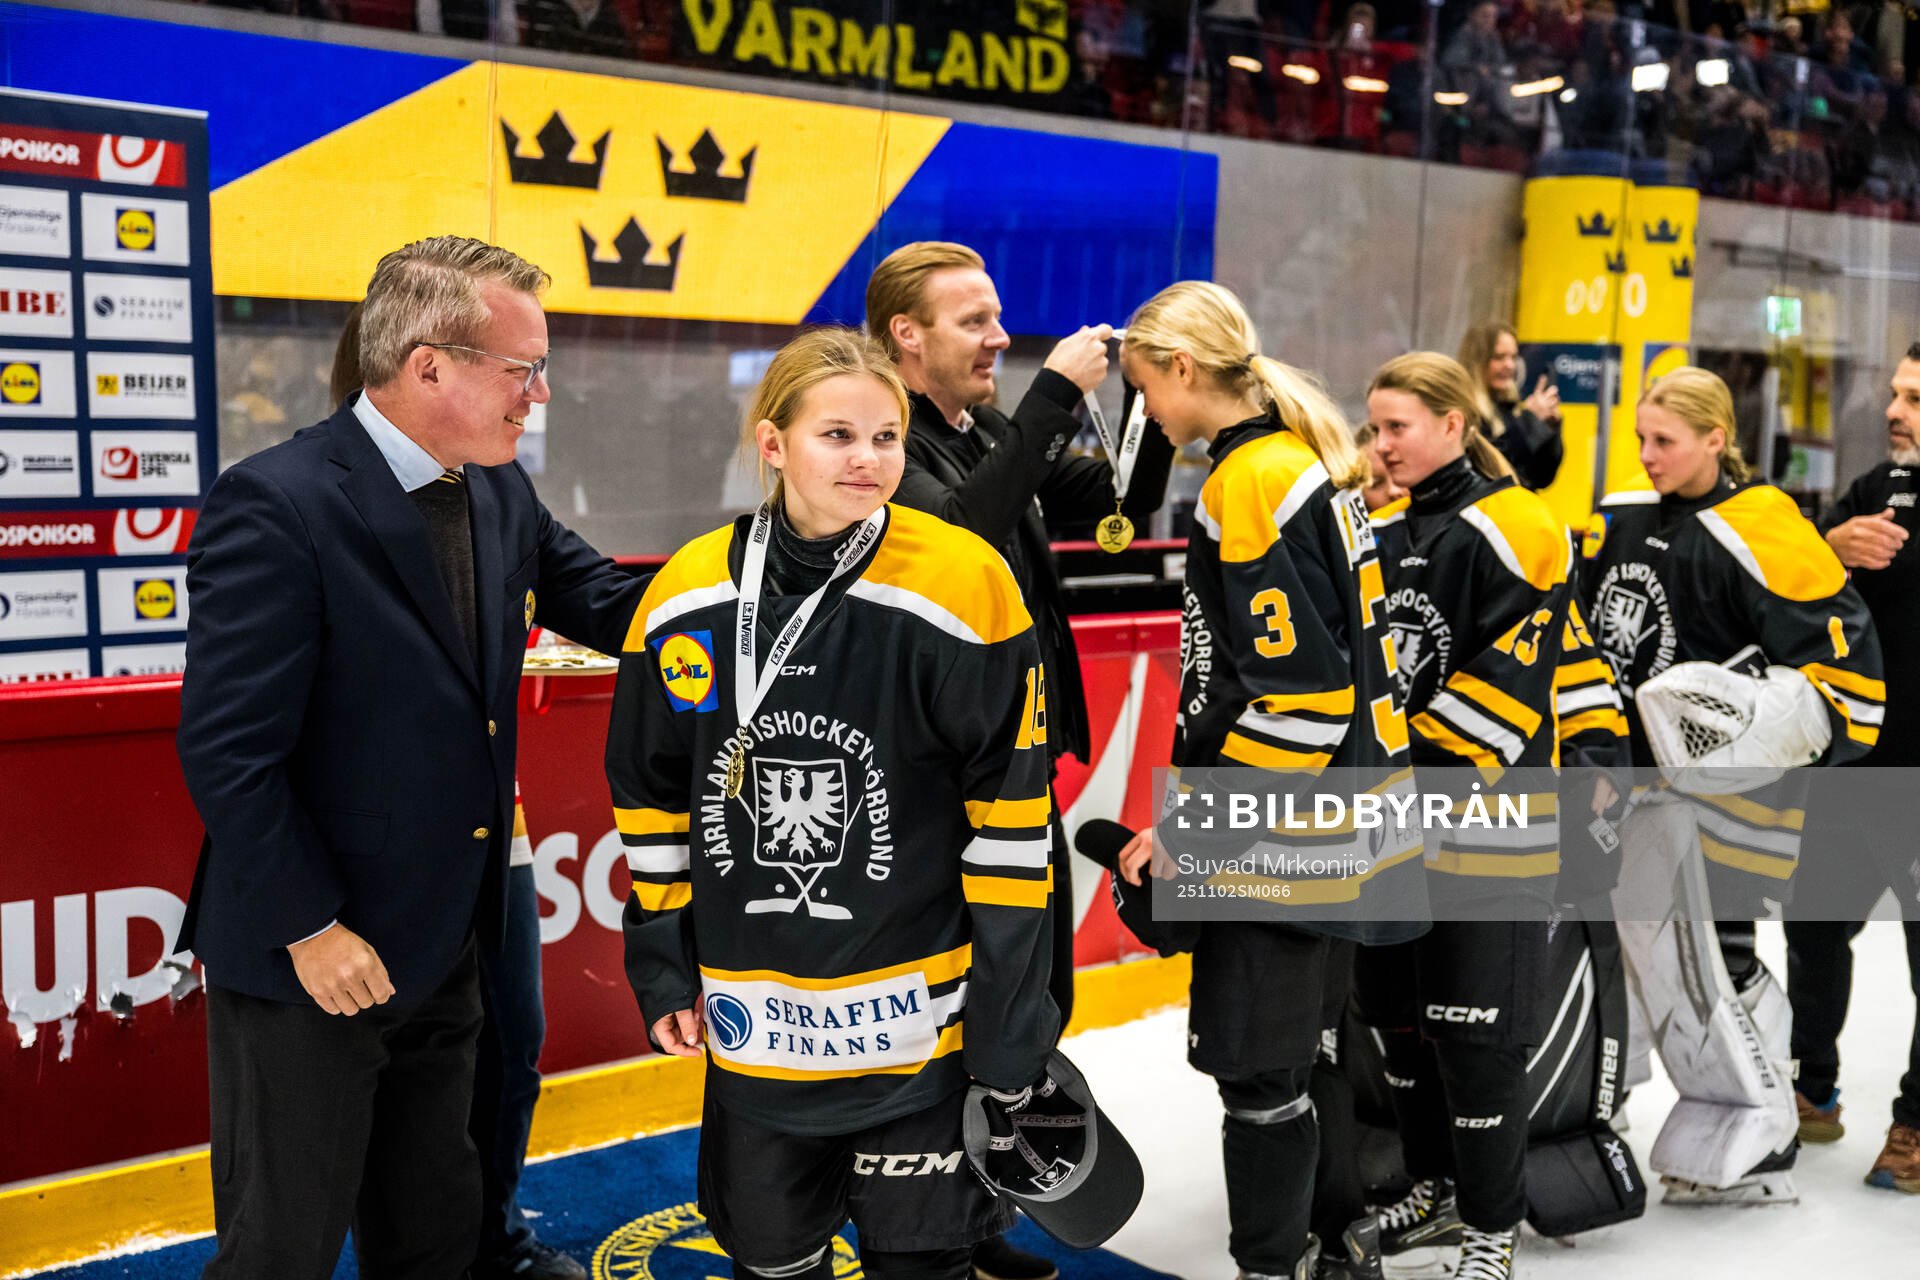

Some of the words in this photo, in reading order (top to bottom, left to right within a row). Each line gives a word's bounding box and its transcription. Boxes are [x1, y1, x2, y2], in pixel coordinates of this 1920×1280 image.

[0, 137, 79, 165] PONSOR
[124, 373, 187, 392] BEIJER
[1250, 587, 1298, 659] 3
[1828, 616, 1850, 659] 1
[779, 664, 817, 677] CM
[766, 989, 921, 1029] SERAFIM
[1426, 1004, 1499, 1024] CCM
[767, 1032, 891, 1057] FINANS
[1455, 1114, 1503, 1129] CCM
[853, 1150, 964, 1177] CCM
